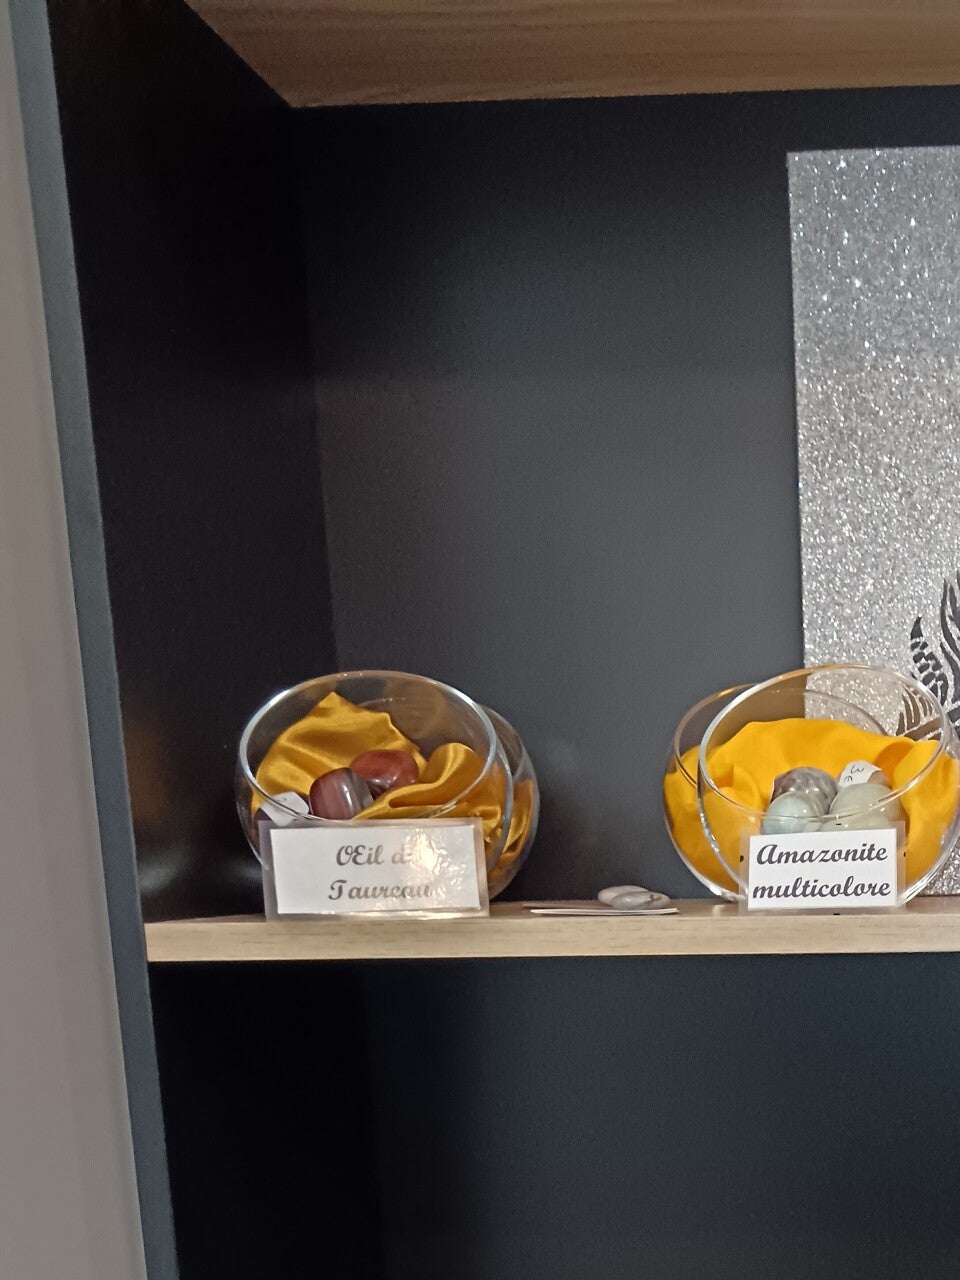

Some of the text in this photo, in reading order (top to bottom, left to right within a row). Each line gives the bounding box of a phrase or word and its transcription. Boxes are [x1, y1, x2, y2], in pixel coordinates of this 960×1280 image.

[756, 842, 889, 866] Amazonite
[327, 879, 432, 901] Taureau
[752, 875, 892, 899] multicolore
